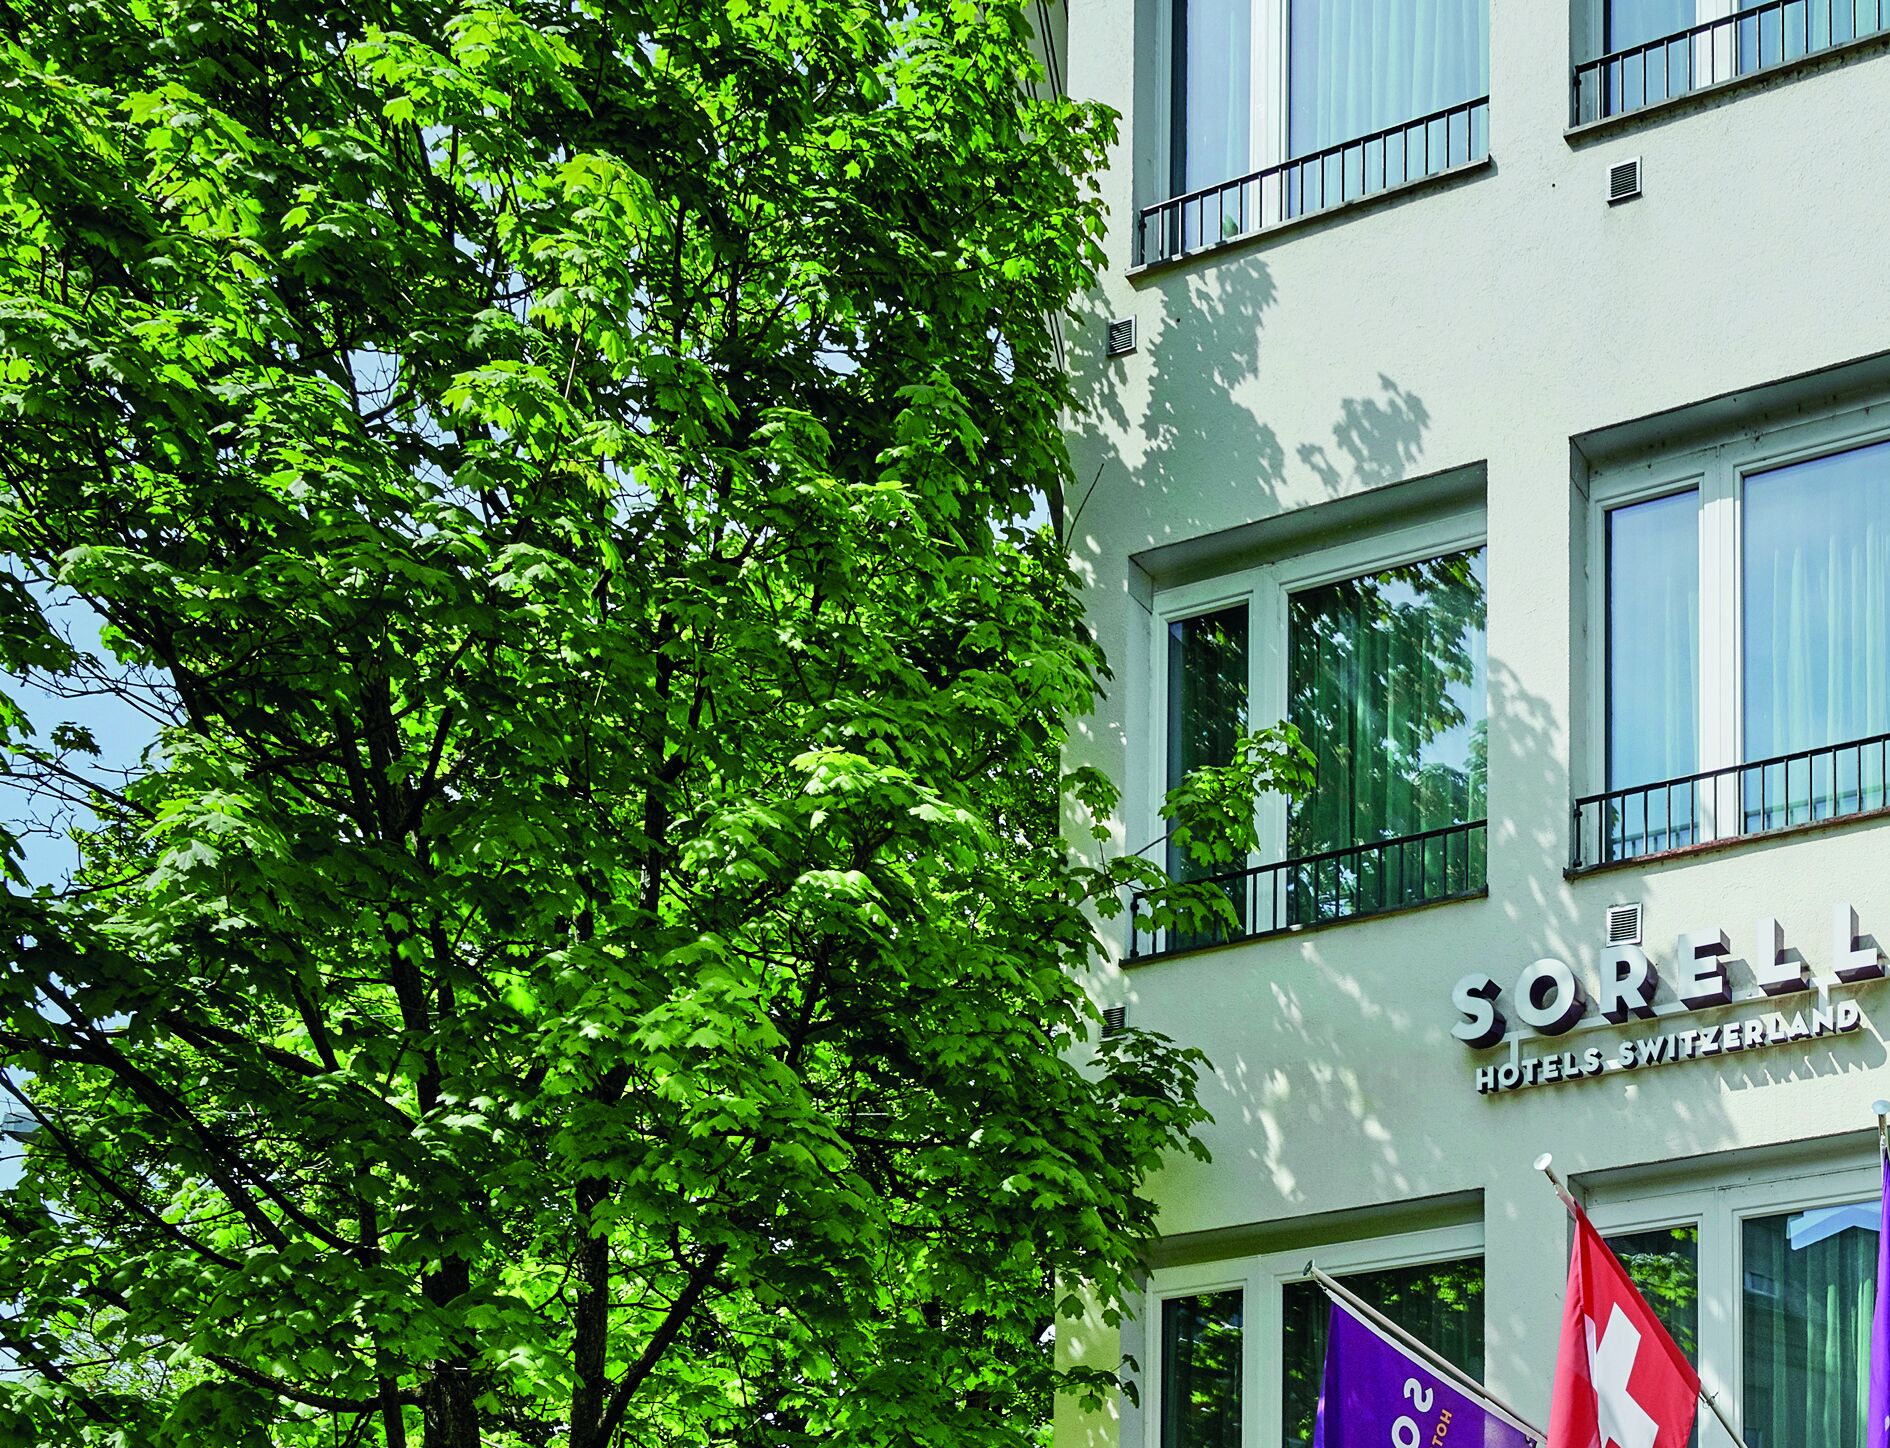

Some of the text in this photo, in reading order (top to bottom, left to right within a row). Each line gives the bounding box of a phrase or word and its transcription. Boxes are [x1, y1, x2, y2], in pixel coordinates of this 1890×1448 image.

[1450, 904, 1883, 1048] SORELL
[1476, 999, 1861, 1095] HOTELS SWITZERLAND
